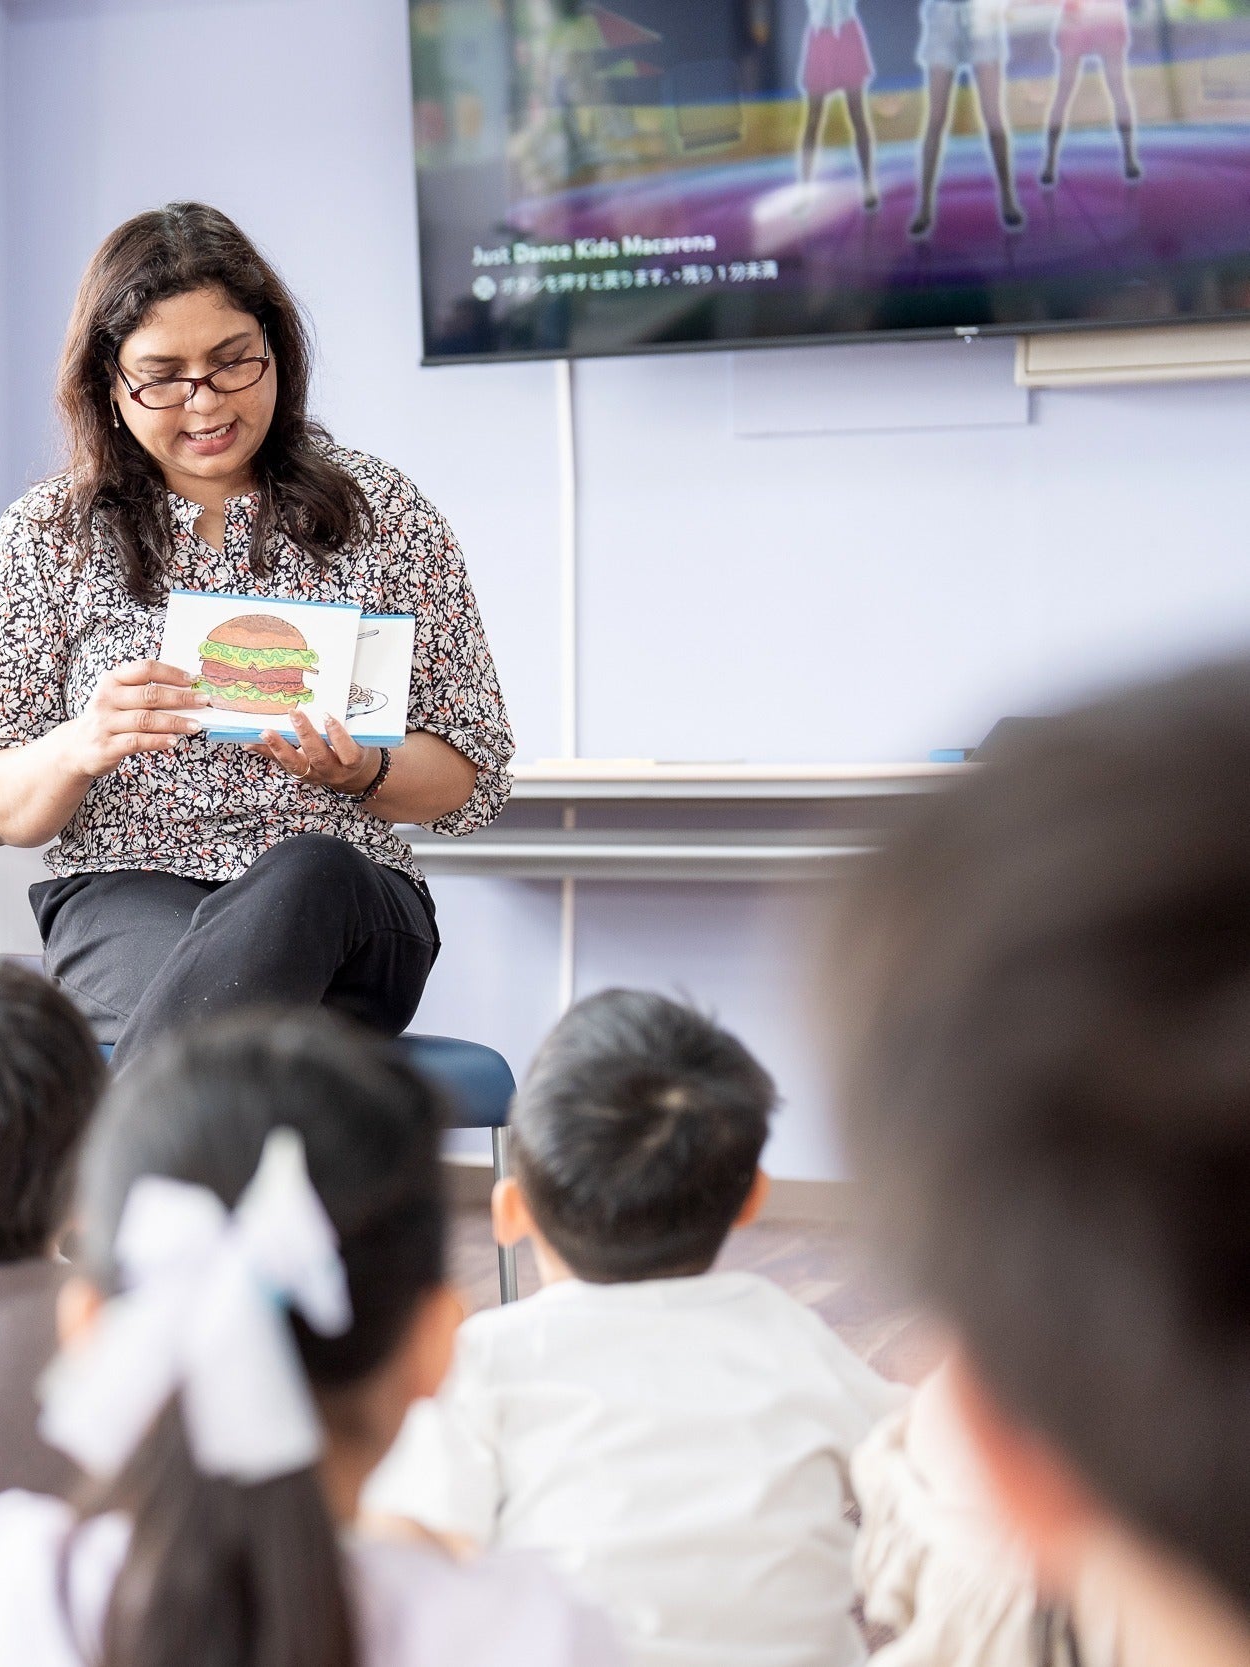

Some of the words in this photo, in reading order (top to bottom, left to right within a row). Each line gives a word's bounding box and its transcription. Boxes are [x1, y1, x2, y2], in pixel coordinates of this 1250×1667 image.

[473, 245, 511, 266] Just
[513, 242, 572, 264] Dance
[574, 237, 619, 260] Kids
[621, 234, 716, 257] Macarena
